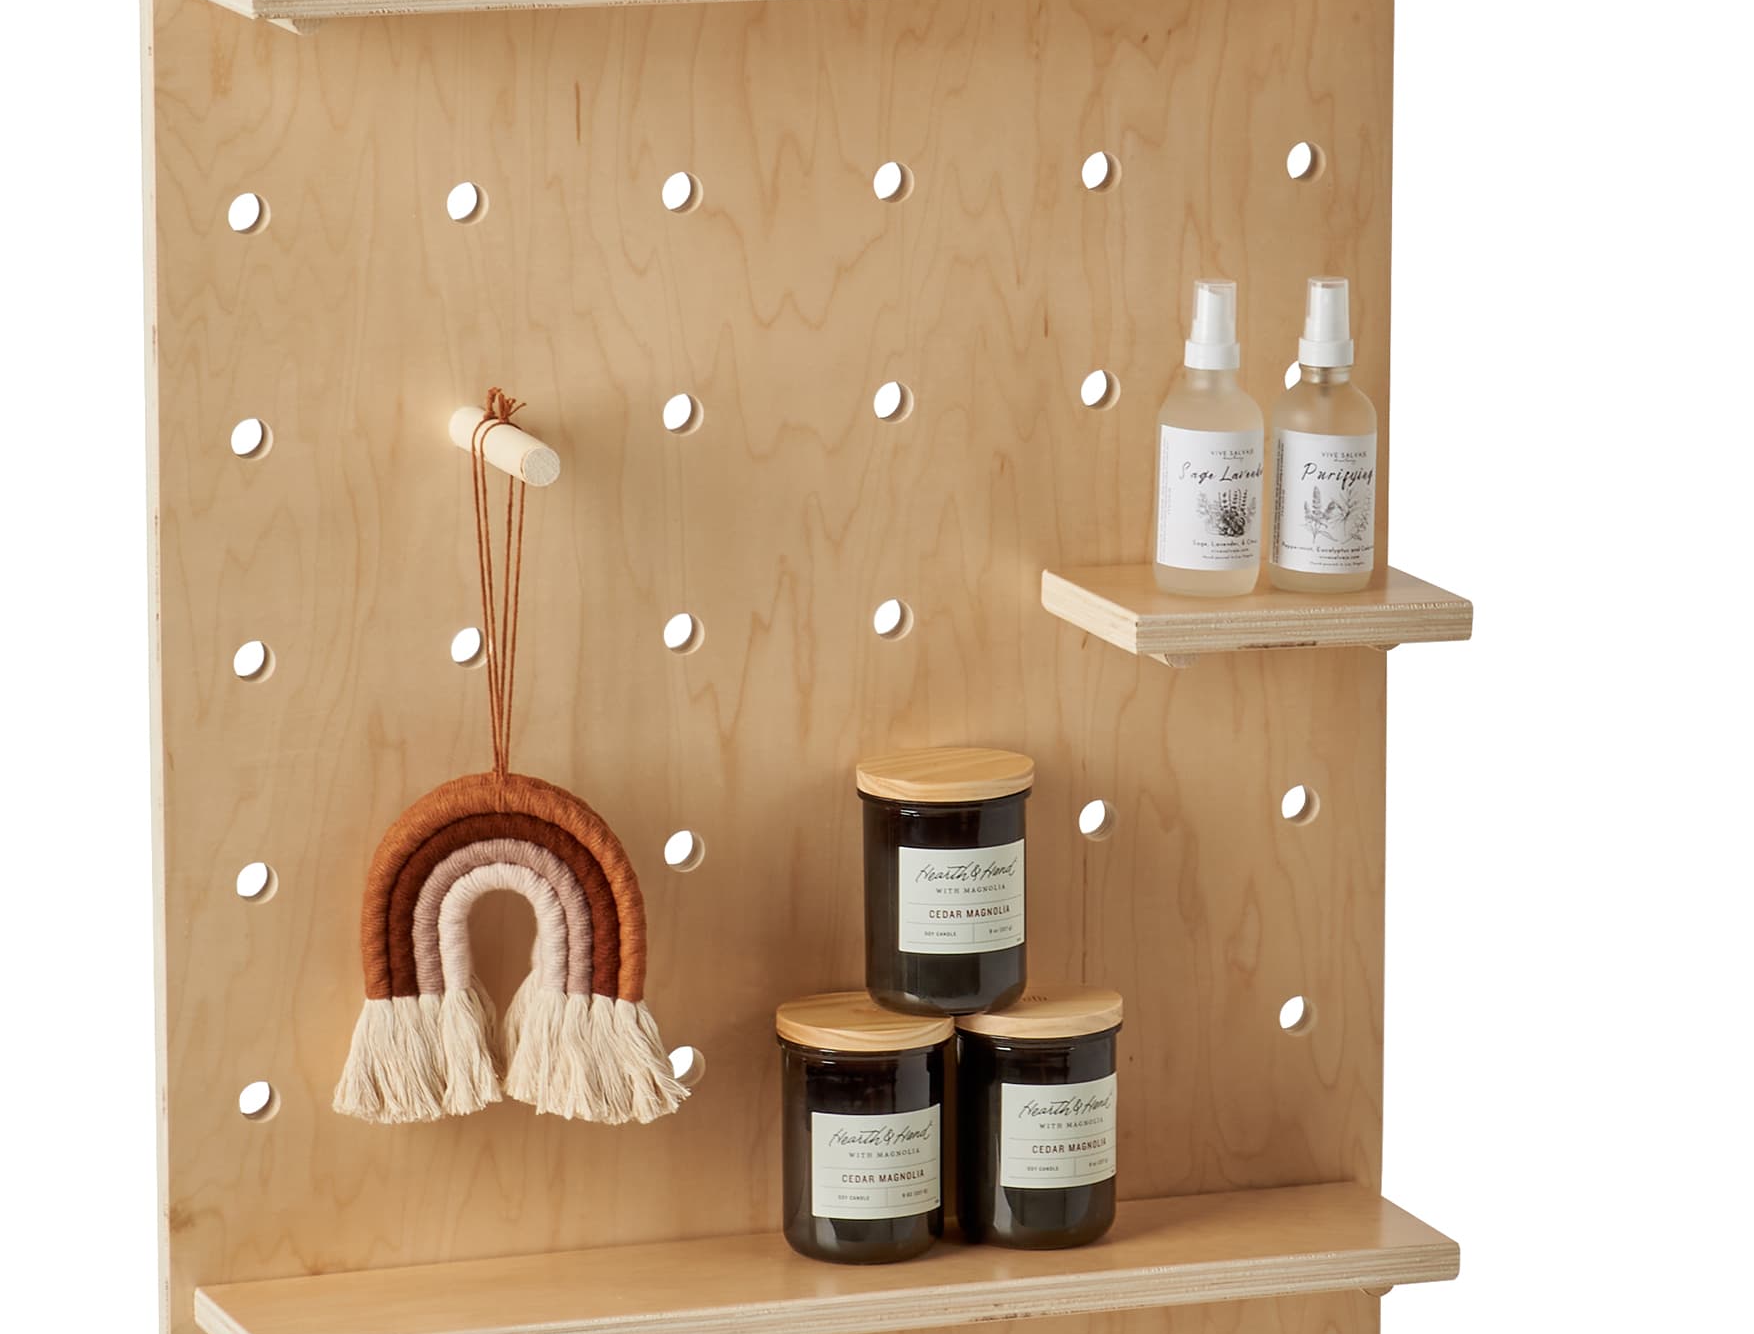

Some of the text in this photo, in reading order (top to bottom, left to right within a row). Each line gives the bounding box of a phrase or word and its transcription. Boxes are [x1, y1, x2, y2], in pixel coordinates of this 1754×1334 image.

[1179, 461, 1214, 484] Sage
[915, 861, 974, 883] Hearth
[980, 856, 1017, 881] Hand
[963, 884, 1006, 894] MAGNOLIA
[929, 905, 1010, 919] CEDAR MAGNOLIA
[1018, 1096, 1076, 1118] Hearth
[1066, 1117, 1104, 1128] MAGNOLIA
[829, 1126, 887, 1147] Hearth
[893, 1120, 933, 1144] Hand
[876, 1147, 920, 1158] MAGNOLIA
[1032, 1137, 1107, 1154] CEDAR MAGNOLIA
[841, 1169, 925, 1184] CEDAR MAGNOLIA
